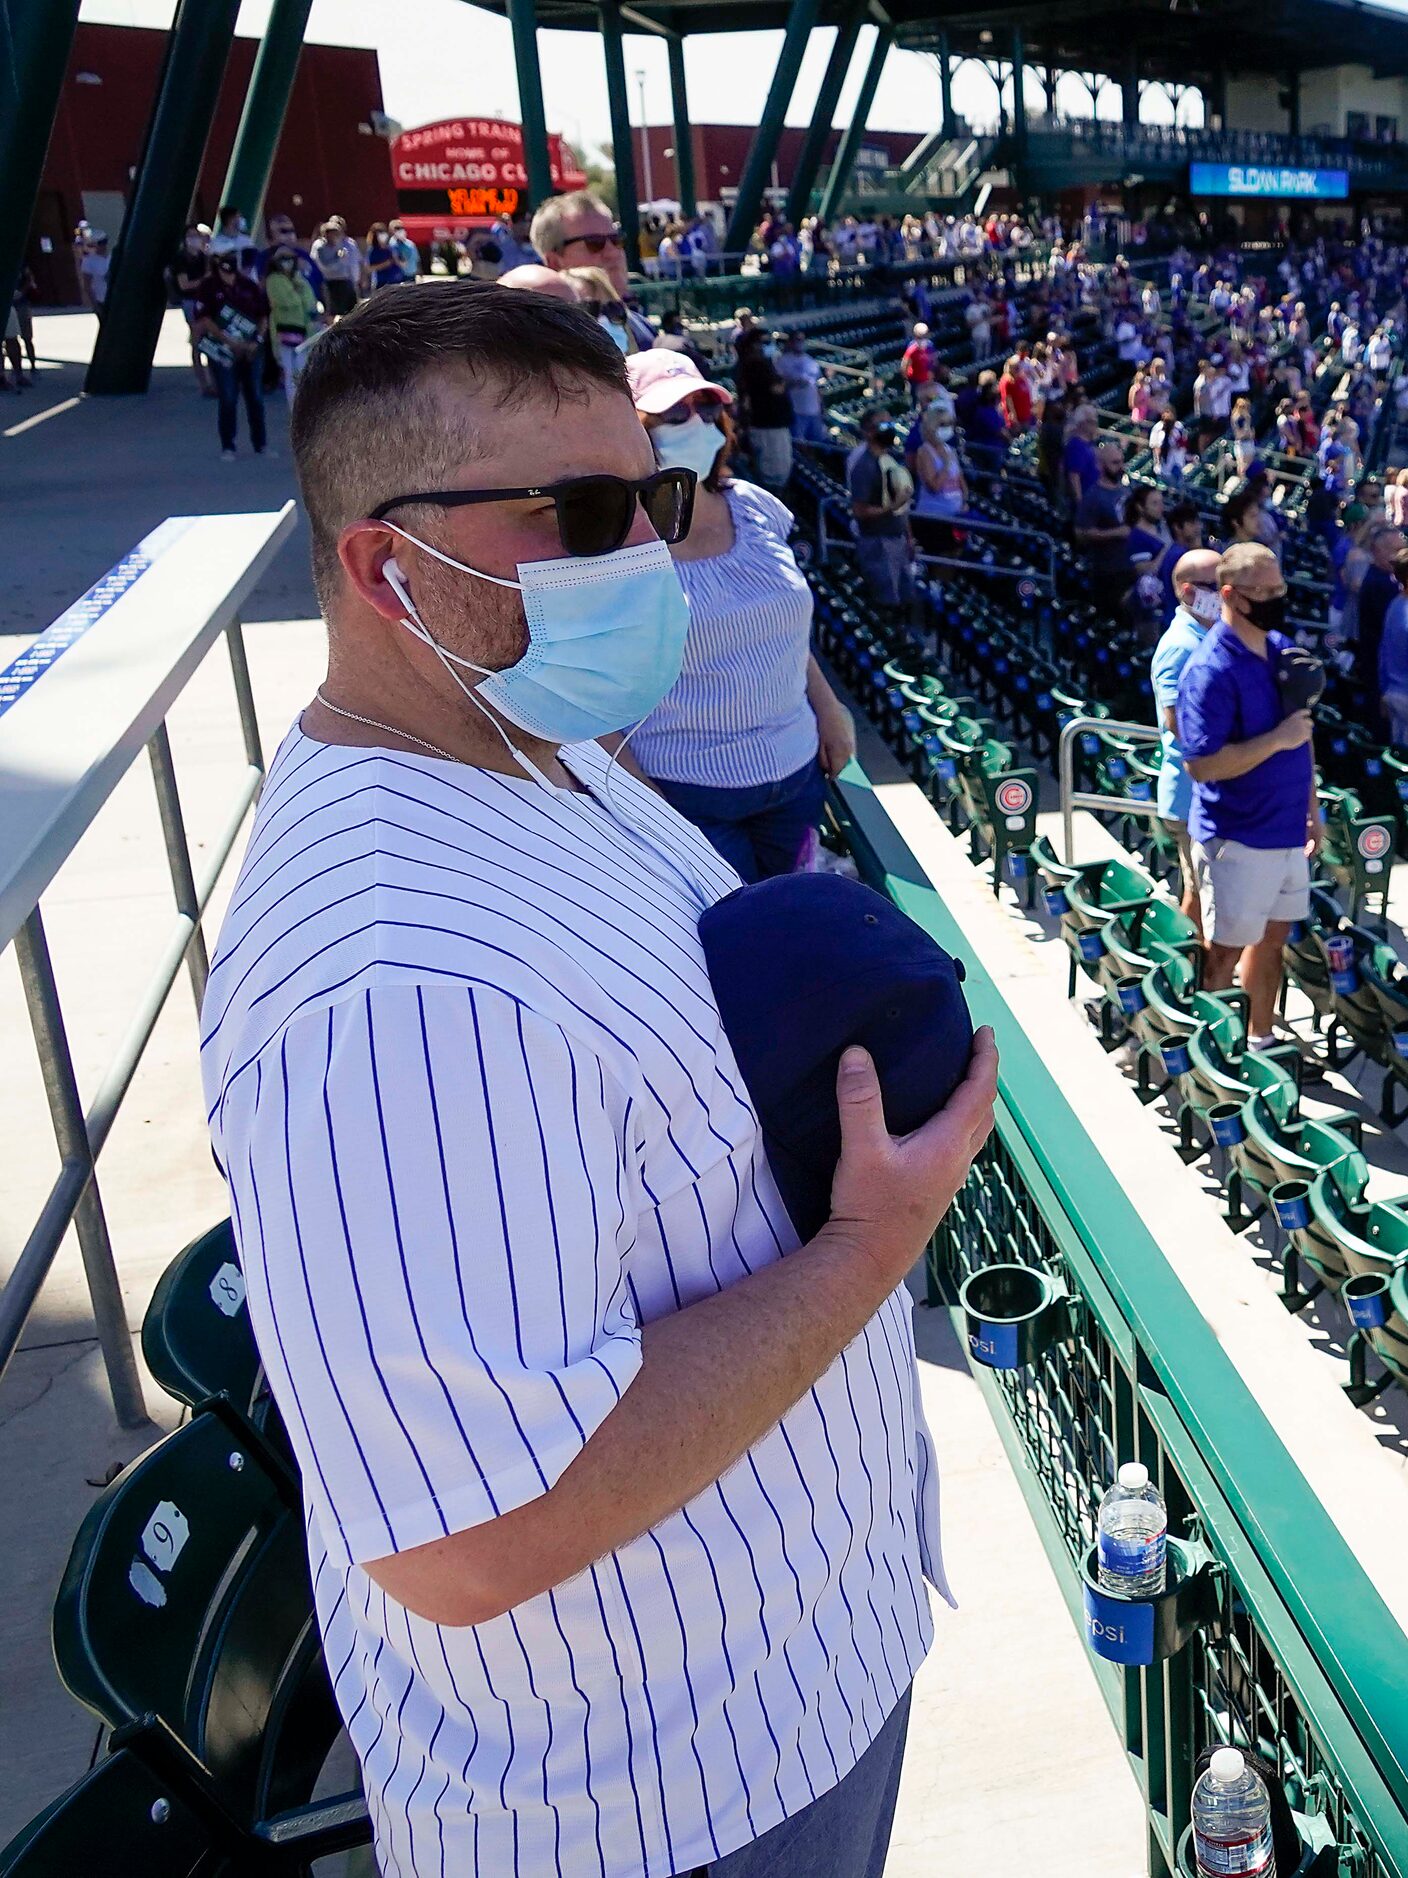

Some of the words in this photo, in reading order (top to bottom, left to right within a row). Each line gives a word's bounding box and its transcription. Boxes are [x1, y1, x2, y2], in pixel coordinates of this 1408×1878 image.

[402, 122, 464, 151] SPRING
[468, 121, 523, 145] TRAIN
[445, 147, 485, 160] HOME
[491, 147, 510, 161] OF
[399, 162, 498, 182] CHICAGO
[501, 163, 560, 183] CUS
[219, 1277, 239, 1301] 8
[967, 1334, 995, 1355] psi
[1084, 1611, 1125, 1644] epsi
